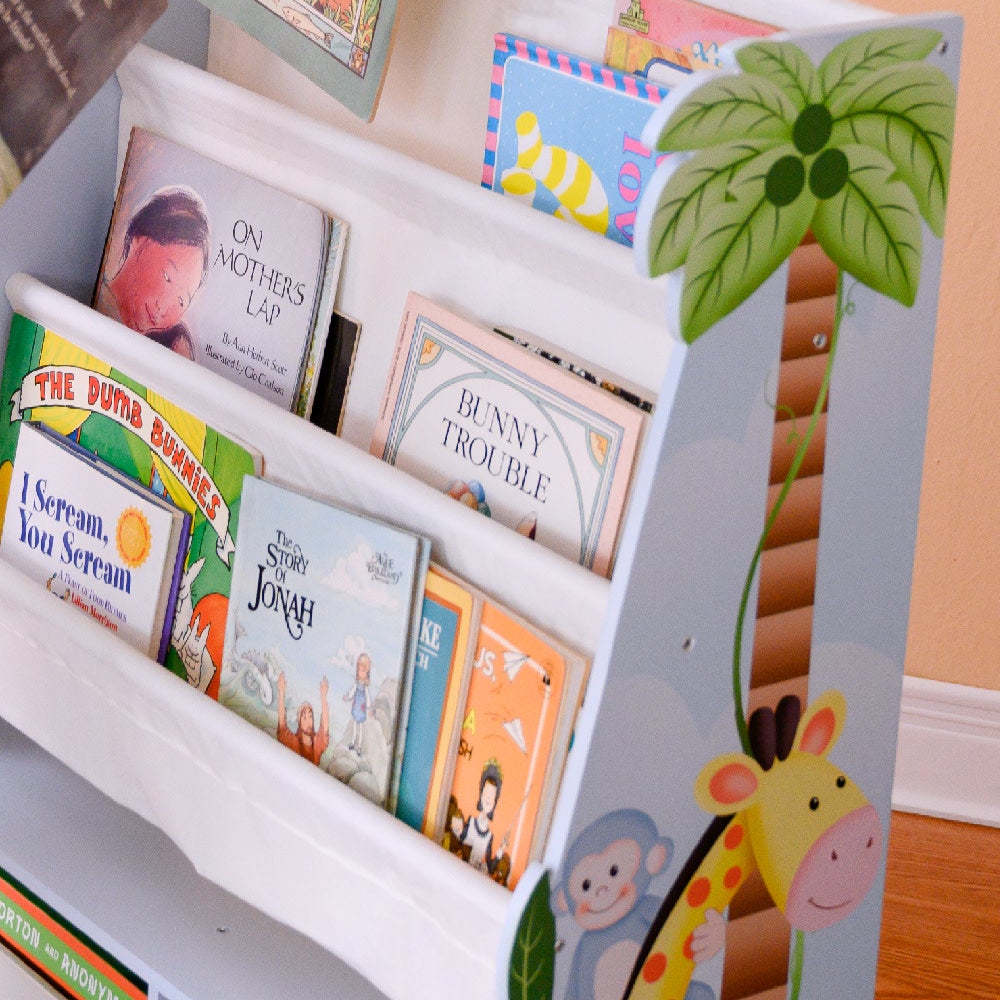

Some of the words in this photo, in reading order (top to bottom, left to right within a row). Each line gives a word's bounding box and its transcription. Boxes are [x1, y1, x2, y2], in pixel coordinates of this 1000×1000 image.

[232, 219, 263, 252] ON
[213, 243, 306, 306] MOTHER'S
[246, 289, 281, 326] LAP
[34, 371, 75, 400] THE
[87, 375, 144, 430] DUMB
[149, 415, 222, 521] BUNNIES
[456, 387, 549, 458] BUNNY
[440, 416, 552, 503] TROUBLE
[20, 470, 30, 506] I
[32, 477, 109, 547] Scream,
[18, 506, 54, 557] You
[60, 530, 132, 595] Scream
[266, 542, 309, 575] STORY
[275, 529, 293, 548] The
[247, 564, 315, 640] JONAH
[420, 617, 442, 650] KE
[416, 651, 430, 670] H
[44, 942, 60, 962] AND
